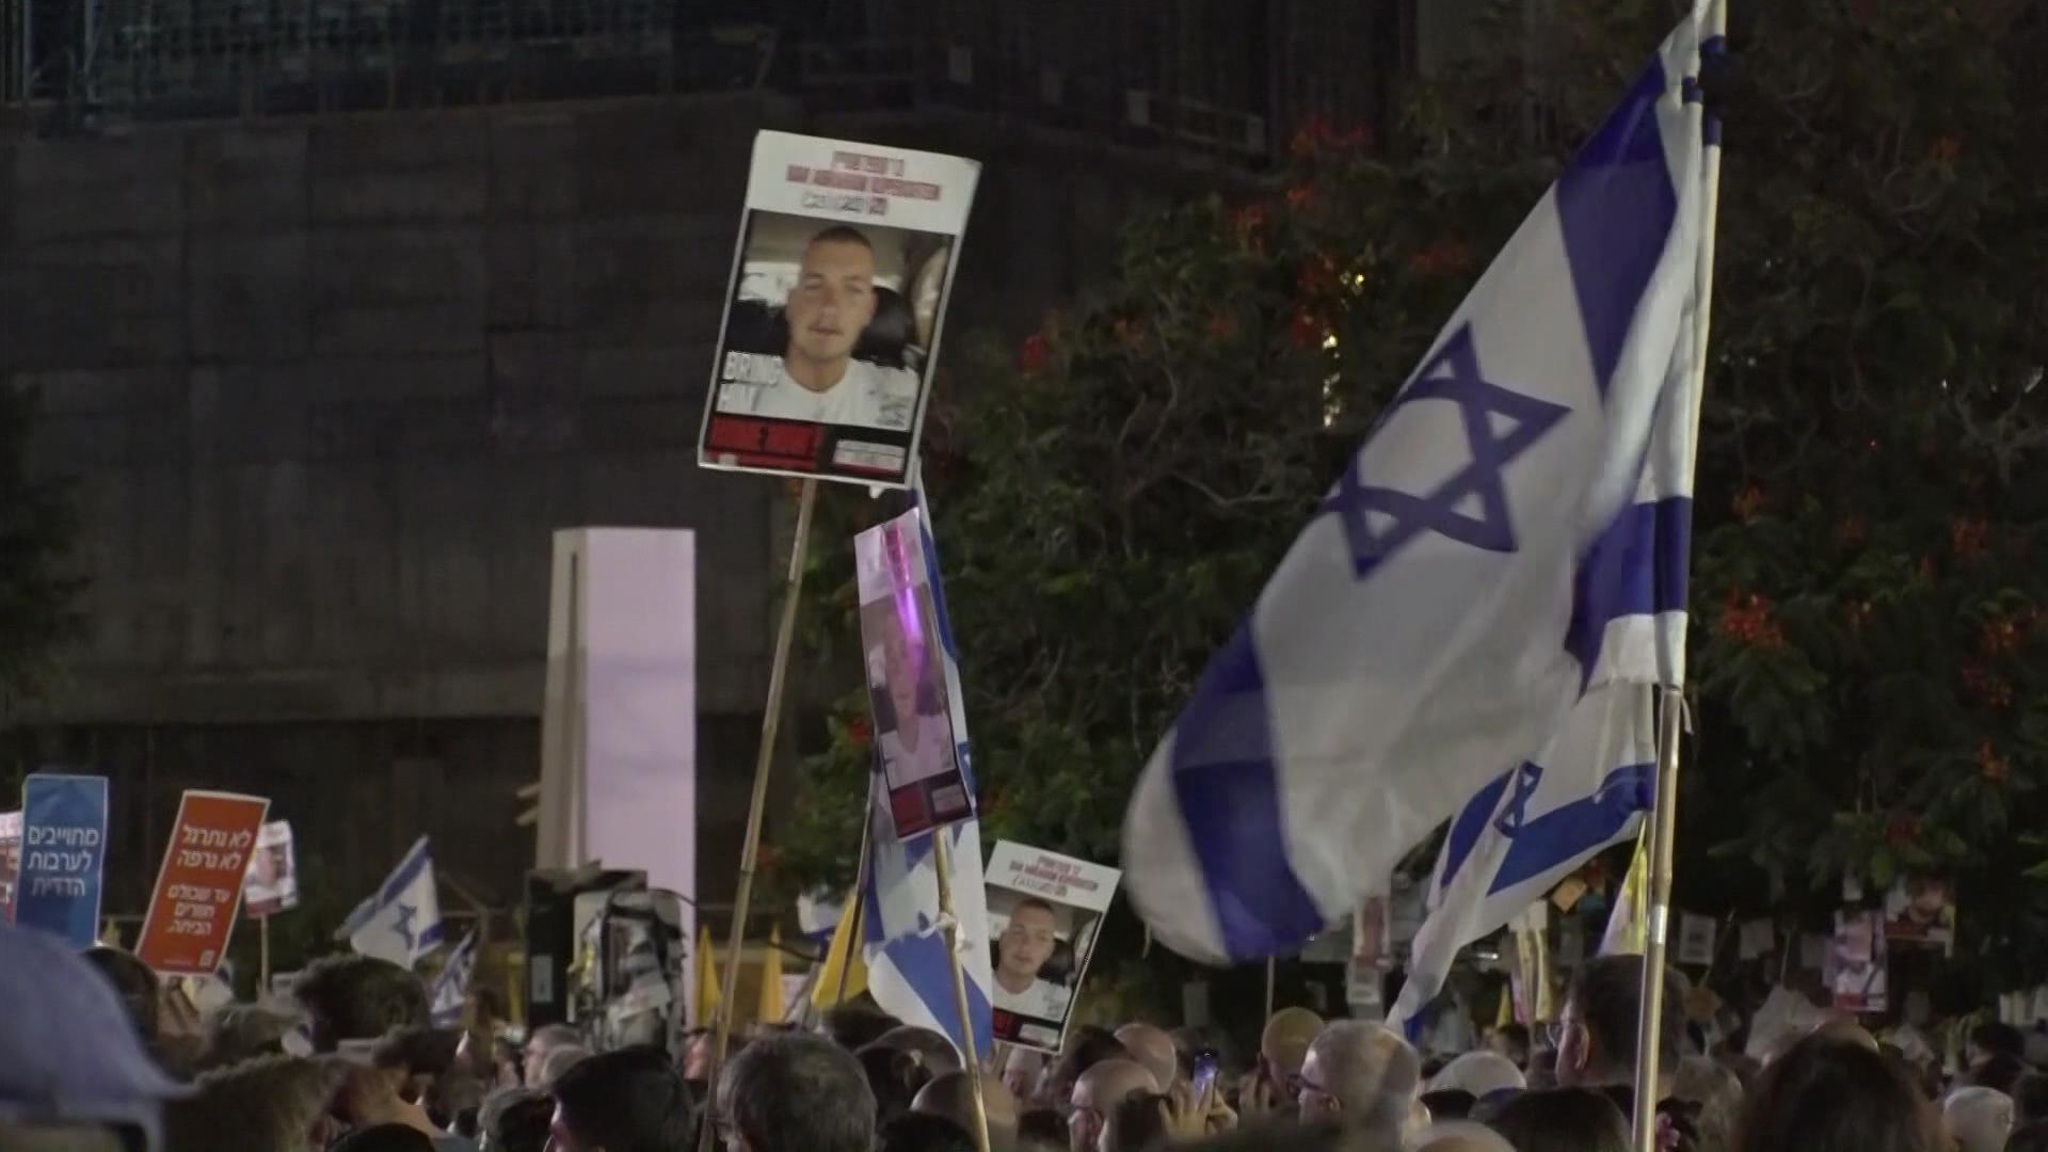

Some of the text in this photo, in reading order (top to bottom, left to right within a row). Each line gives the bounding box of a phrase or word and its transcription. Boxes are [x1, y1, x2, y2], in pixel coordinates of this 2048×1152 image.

[28, 826, 99, 847] מחוייבים
[229, 828, 252, 848] לא
[27, 850, 92, 871] לערבות
[176, 849, 242, 870] לא נרפה
[32, 877, 85, 897] הדדית
